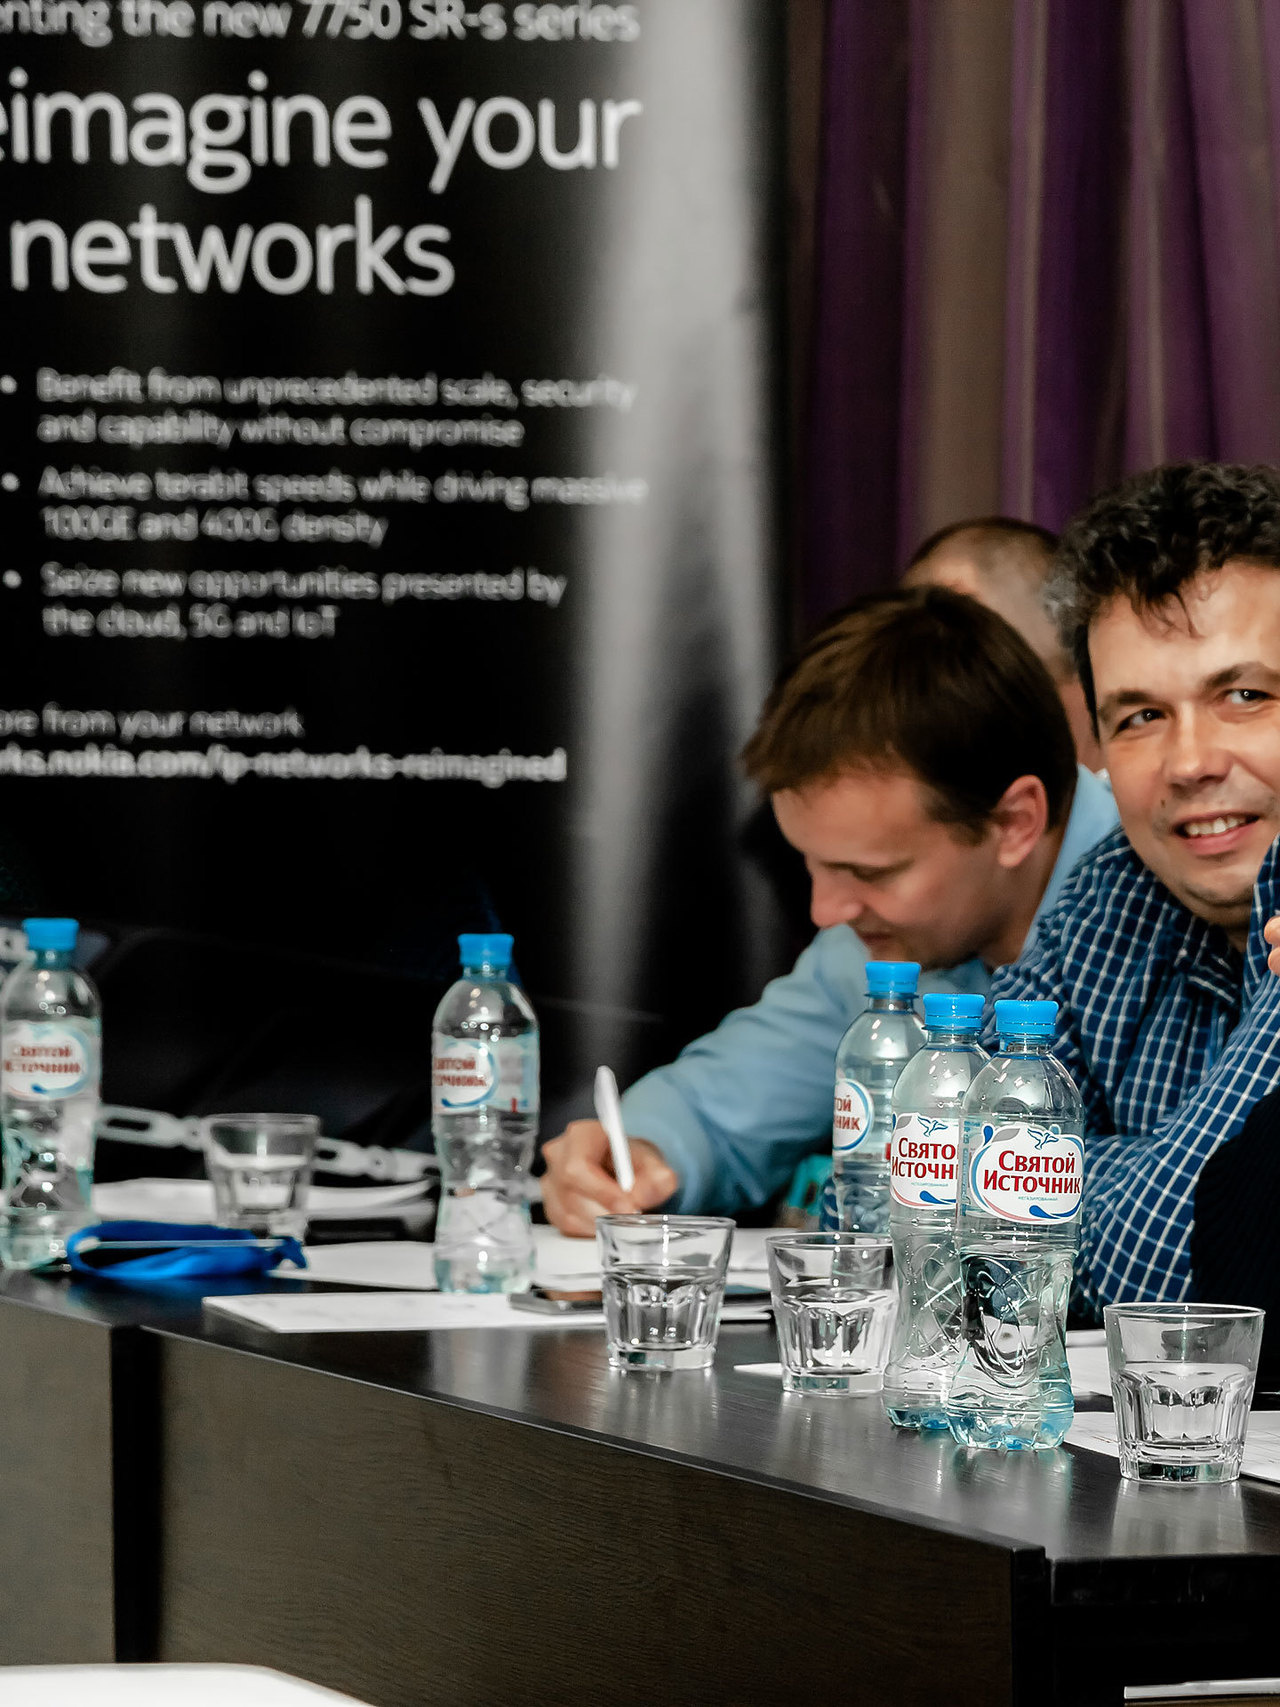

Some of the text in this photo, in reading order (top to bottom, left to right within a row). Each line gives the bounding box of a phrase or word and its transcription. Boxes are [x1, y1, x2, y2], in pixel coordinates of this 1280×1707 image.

[120, 0, 195, 38] the
[203, 0, 292, 38] new
[302, 0, 400, 40] 7750
[409, 0, 507, 41] SR-s
[513, 0, 641, 42] series
[417, 96, 643, 194] your
[10, 194, 455, 296] networks
[37, 367, 142, 403] Benefit
[148, 367, 222, 404] from
[223, 371, 437, 412] unprecedented
[440, 373, 519, 411] scale,
[37, 408, 525, 450] and capability without compromise
[38, 466, 648, 511] Achieve terabit speeds while driving massive
[138, 507, 198, 541] and
[281, 508, 389, 548] density
[41, 561, 567, 608] Seize new opportunities presented by
[42, 602, 95, 637] the
[97, 602, 187, 640] cloud,
[234, 604, 290, 638] and
[42, 701, 116, 737] from
[117, 710, 188, 743] your
[190, 706, 304, 738] network
[898, 1137, 960, 1160] Свято
[998, 1150, 1076, 1174] Святой
[983, 1169, 1082, 1194] Источник
